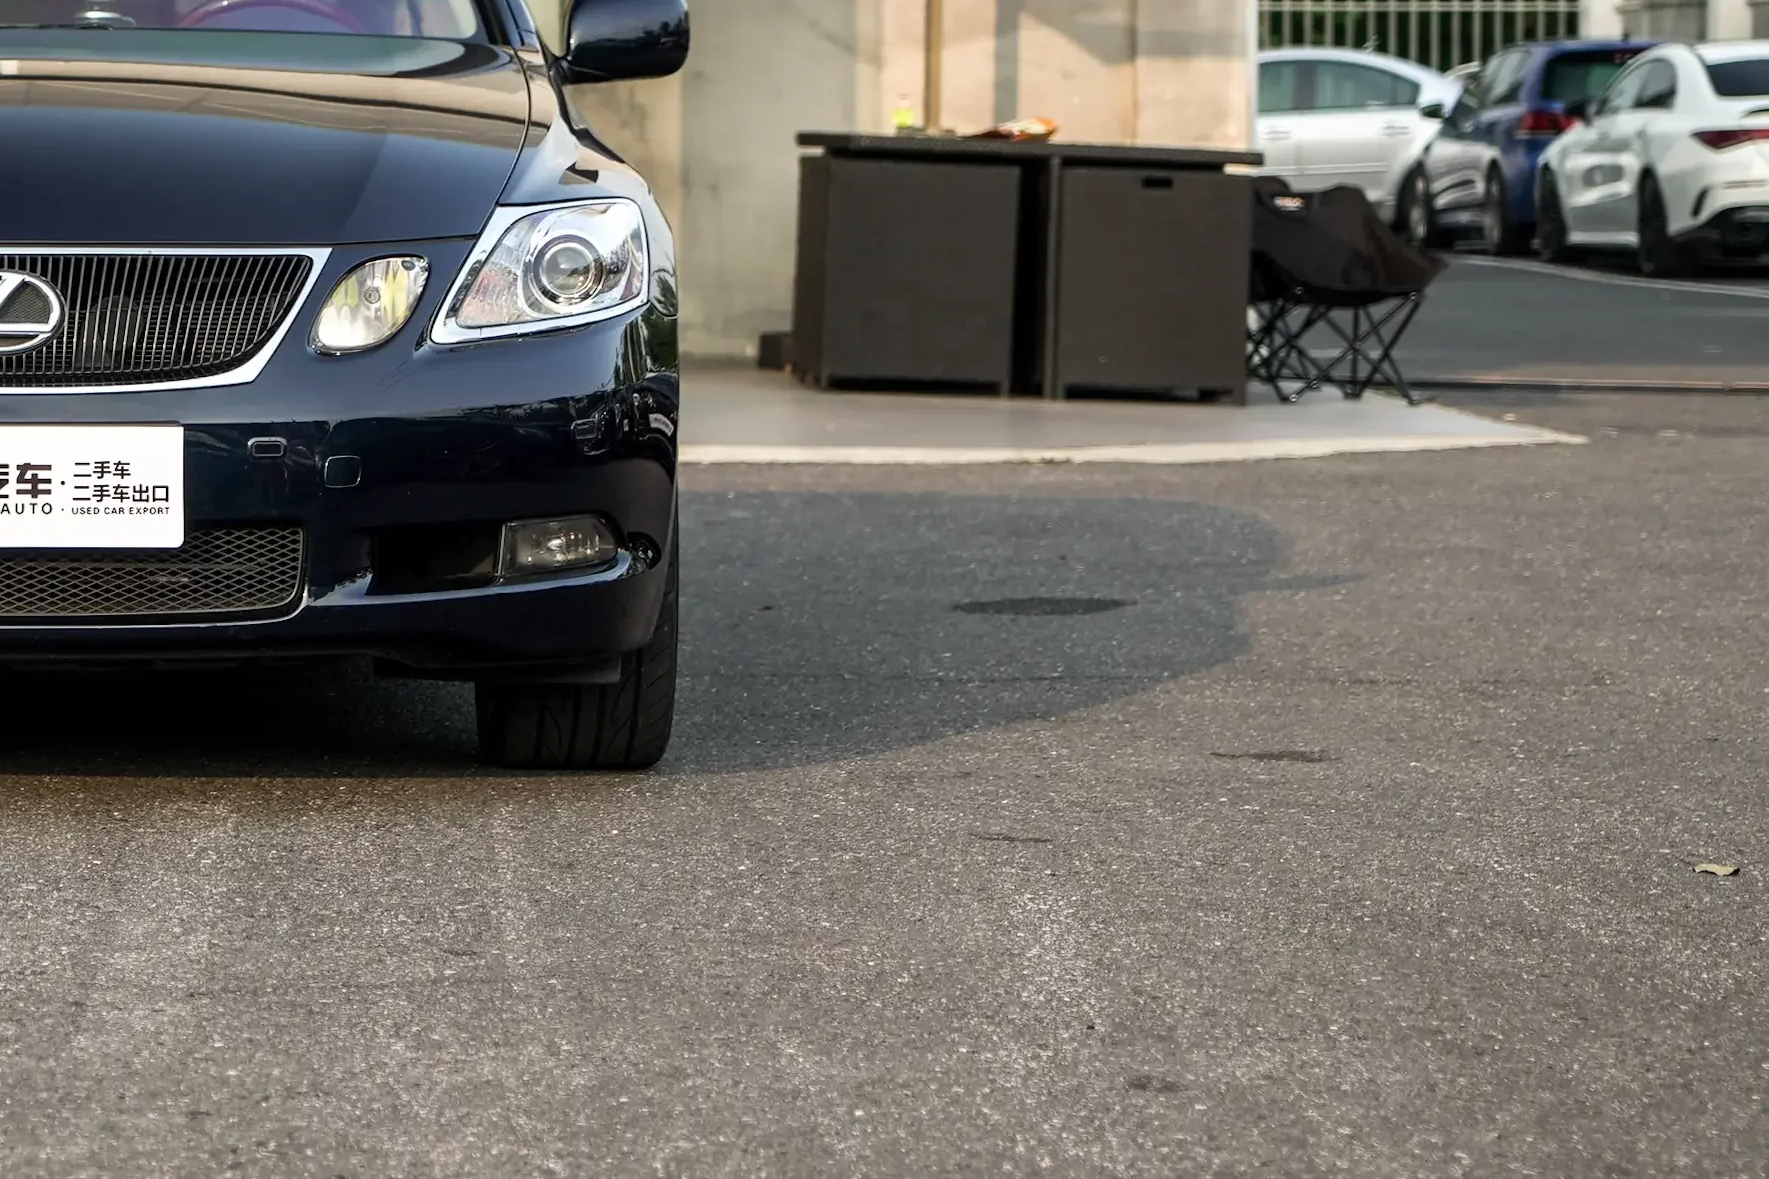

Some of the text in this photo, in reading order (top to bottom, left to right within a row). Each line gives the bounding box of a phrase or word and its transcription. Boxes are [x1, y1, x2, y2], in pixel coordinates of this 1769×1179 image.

[73, 460, 132, 480] 二手车
[72, 483, 170, 504] 二手车出口
[0, 502, 53, 516] AUTO
[71, 506, 170, 515] USED CAR EXPORT
